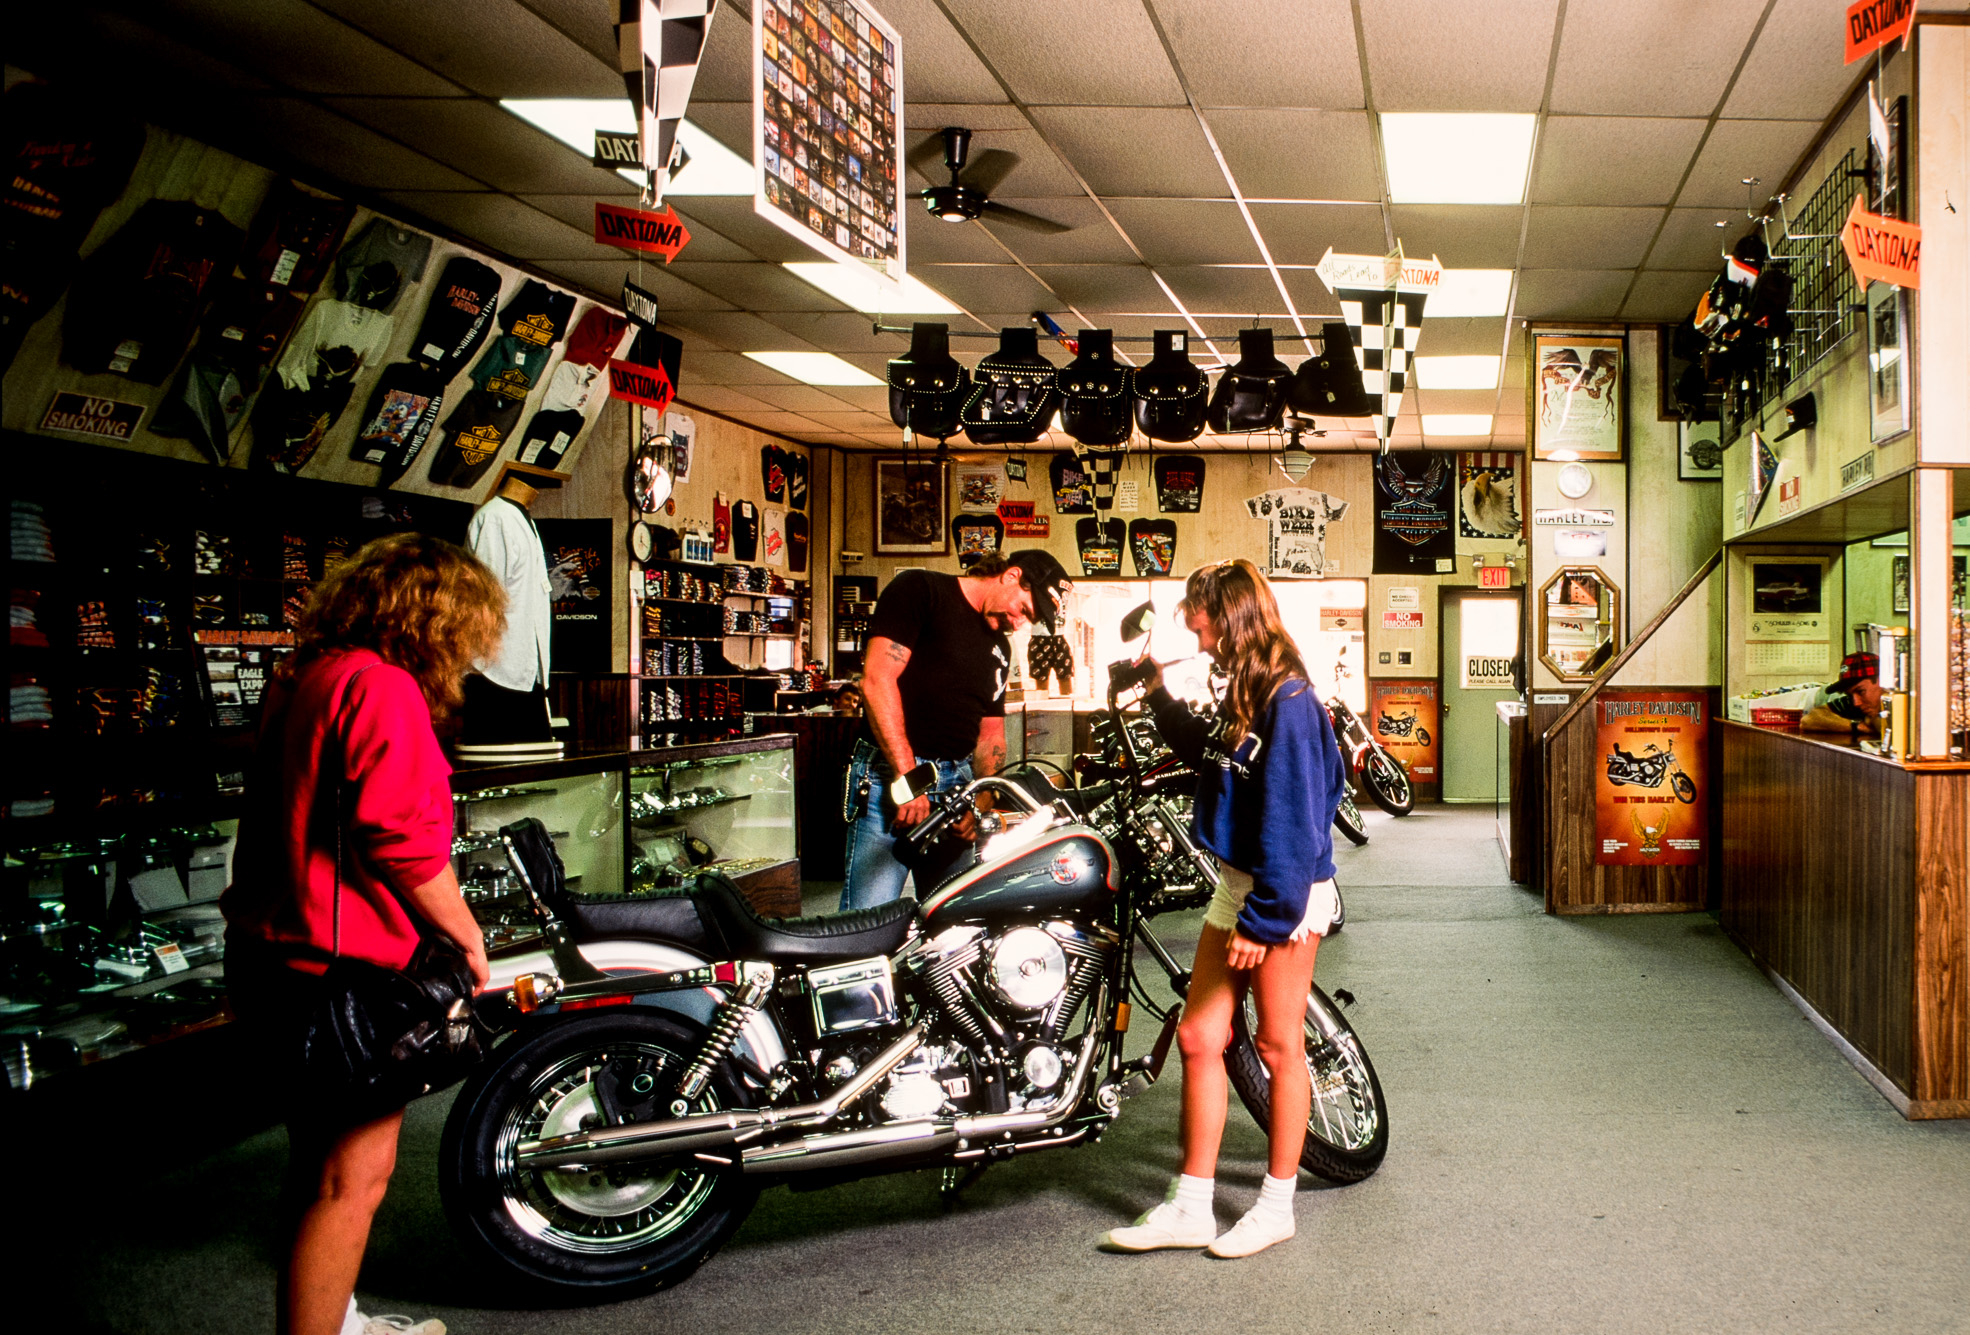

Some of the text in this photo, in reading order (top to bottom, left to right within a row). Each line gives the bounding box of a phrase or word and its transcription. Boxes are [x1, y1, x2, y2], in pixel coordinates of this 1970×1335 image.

[1850, 0, 1912, 45] DAYTONA
[594, 136, 683, 167] DAYTA
[599, 212, 683, 247] DAYTONA
[1852, 222, 1921, 273] DAYTONA
[624, 286, 658, 326] DAYTONA
[610, 367, 669, 403] DAYTONA
[81, 398, 115, 418] NO
[423, 395, 442, 424] HARLEY
[47, 411, 128, 436] SMOKING
[401, 434, 426, 466] DAVIDSON
[1062, 468, 1084, 487] BIKE
[998, 505, 1034, 519] DAYTONA
[1279, 505, 1315, 520] BIKE
[1279, 519, 1315, 531] WEEK
[1482, 567, 1508, 586] EXIT
[553, 602, 576, 613] LEY
[1396, 612, 1411, 620] NO
[1384, 619, 1421, 627] SMOKING
[196, 629, 296, 646] HARLEY-DAVIDSON
[237, 667, 264, 679] EAGLE
[1469, 659, 1511, 677] CLOSED
[1605, 701, 1701, 725] HARLEY-DAVIDSON
[1613, 796, 1676, 804] WIN THIS HARLEY
